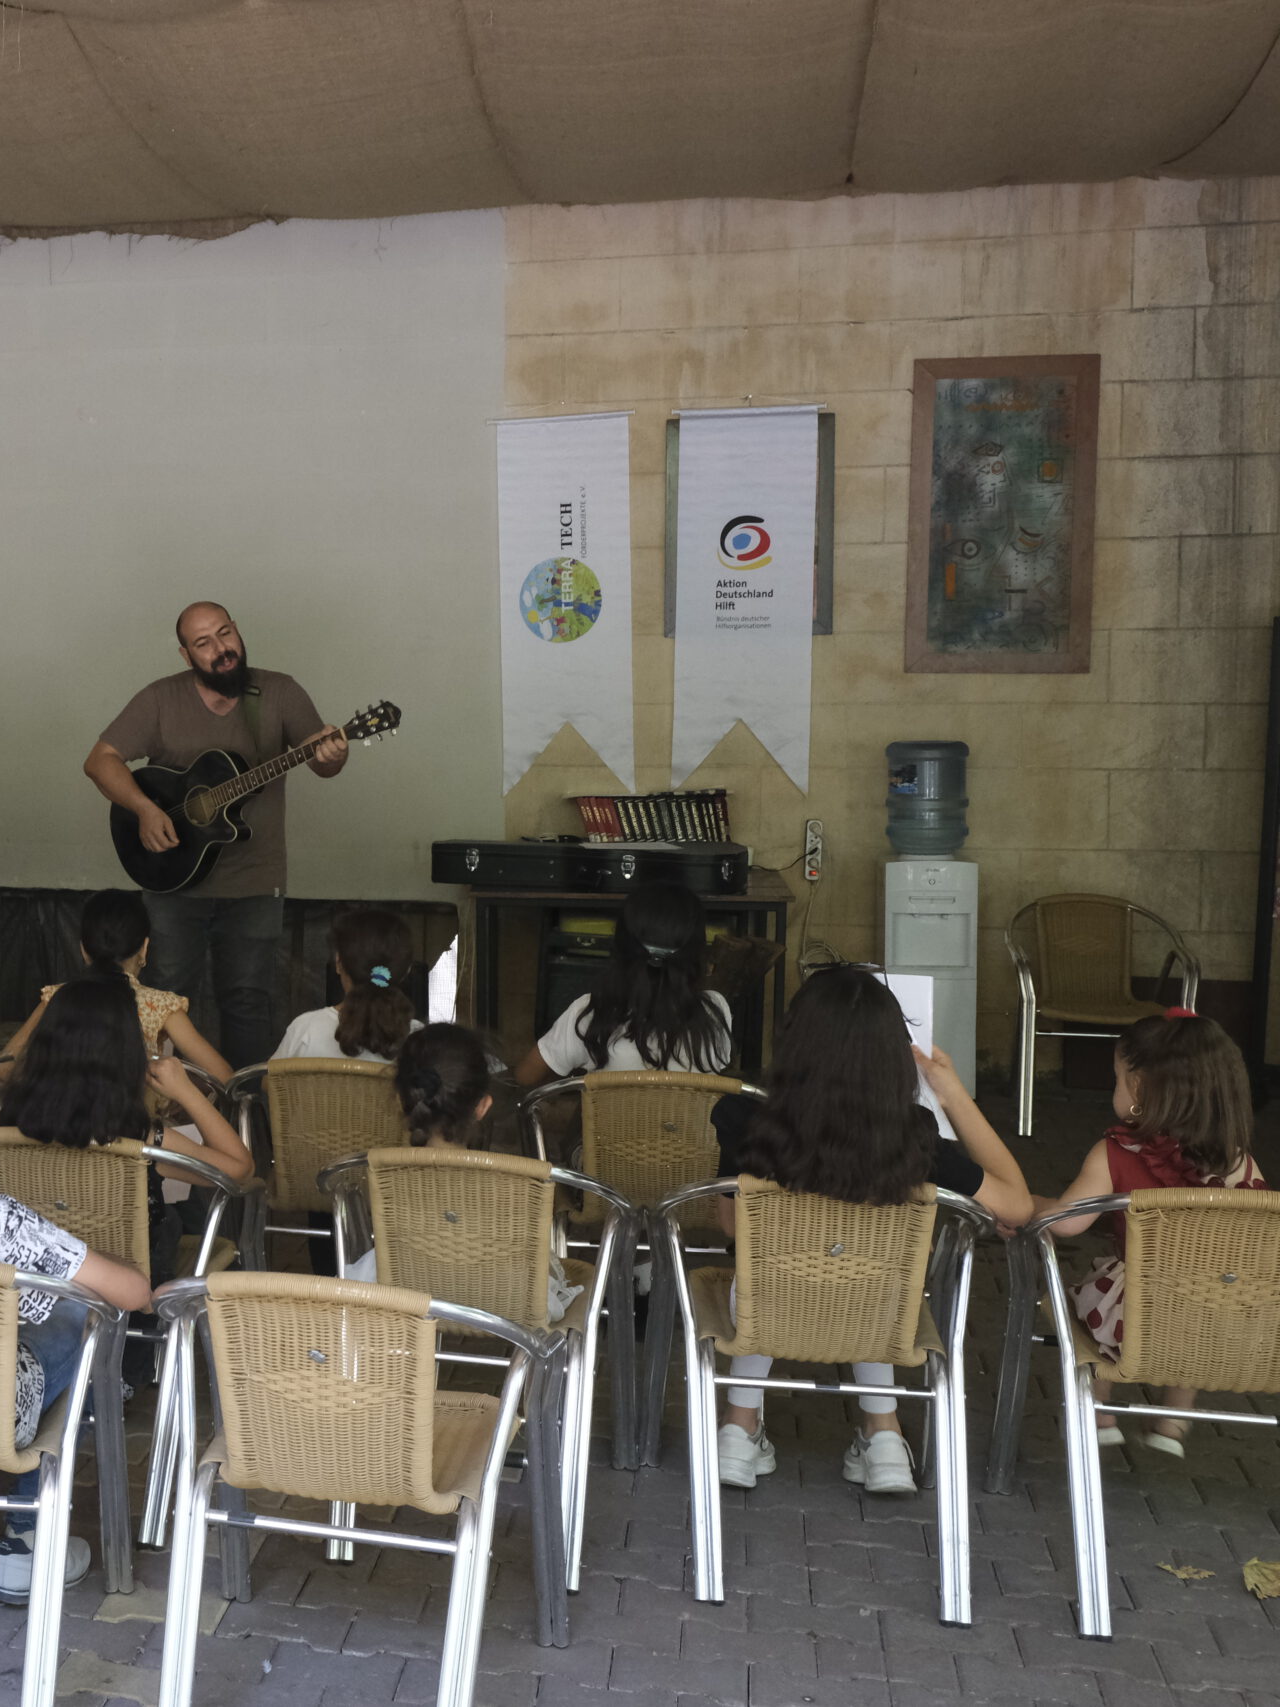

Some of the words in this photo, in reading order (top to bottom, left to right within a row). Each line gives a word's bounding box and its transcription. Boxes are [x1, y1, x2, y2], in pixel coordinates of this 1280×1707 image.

[559, 502, 573, 550] TECH
[561, 557, 574, 613] TERRA
[716, 579, 747, 588] Aktion
[715, 589, 773, 599] Deutschland
[715, 601, 735, 610] Hilft
